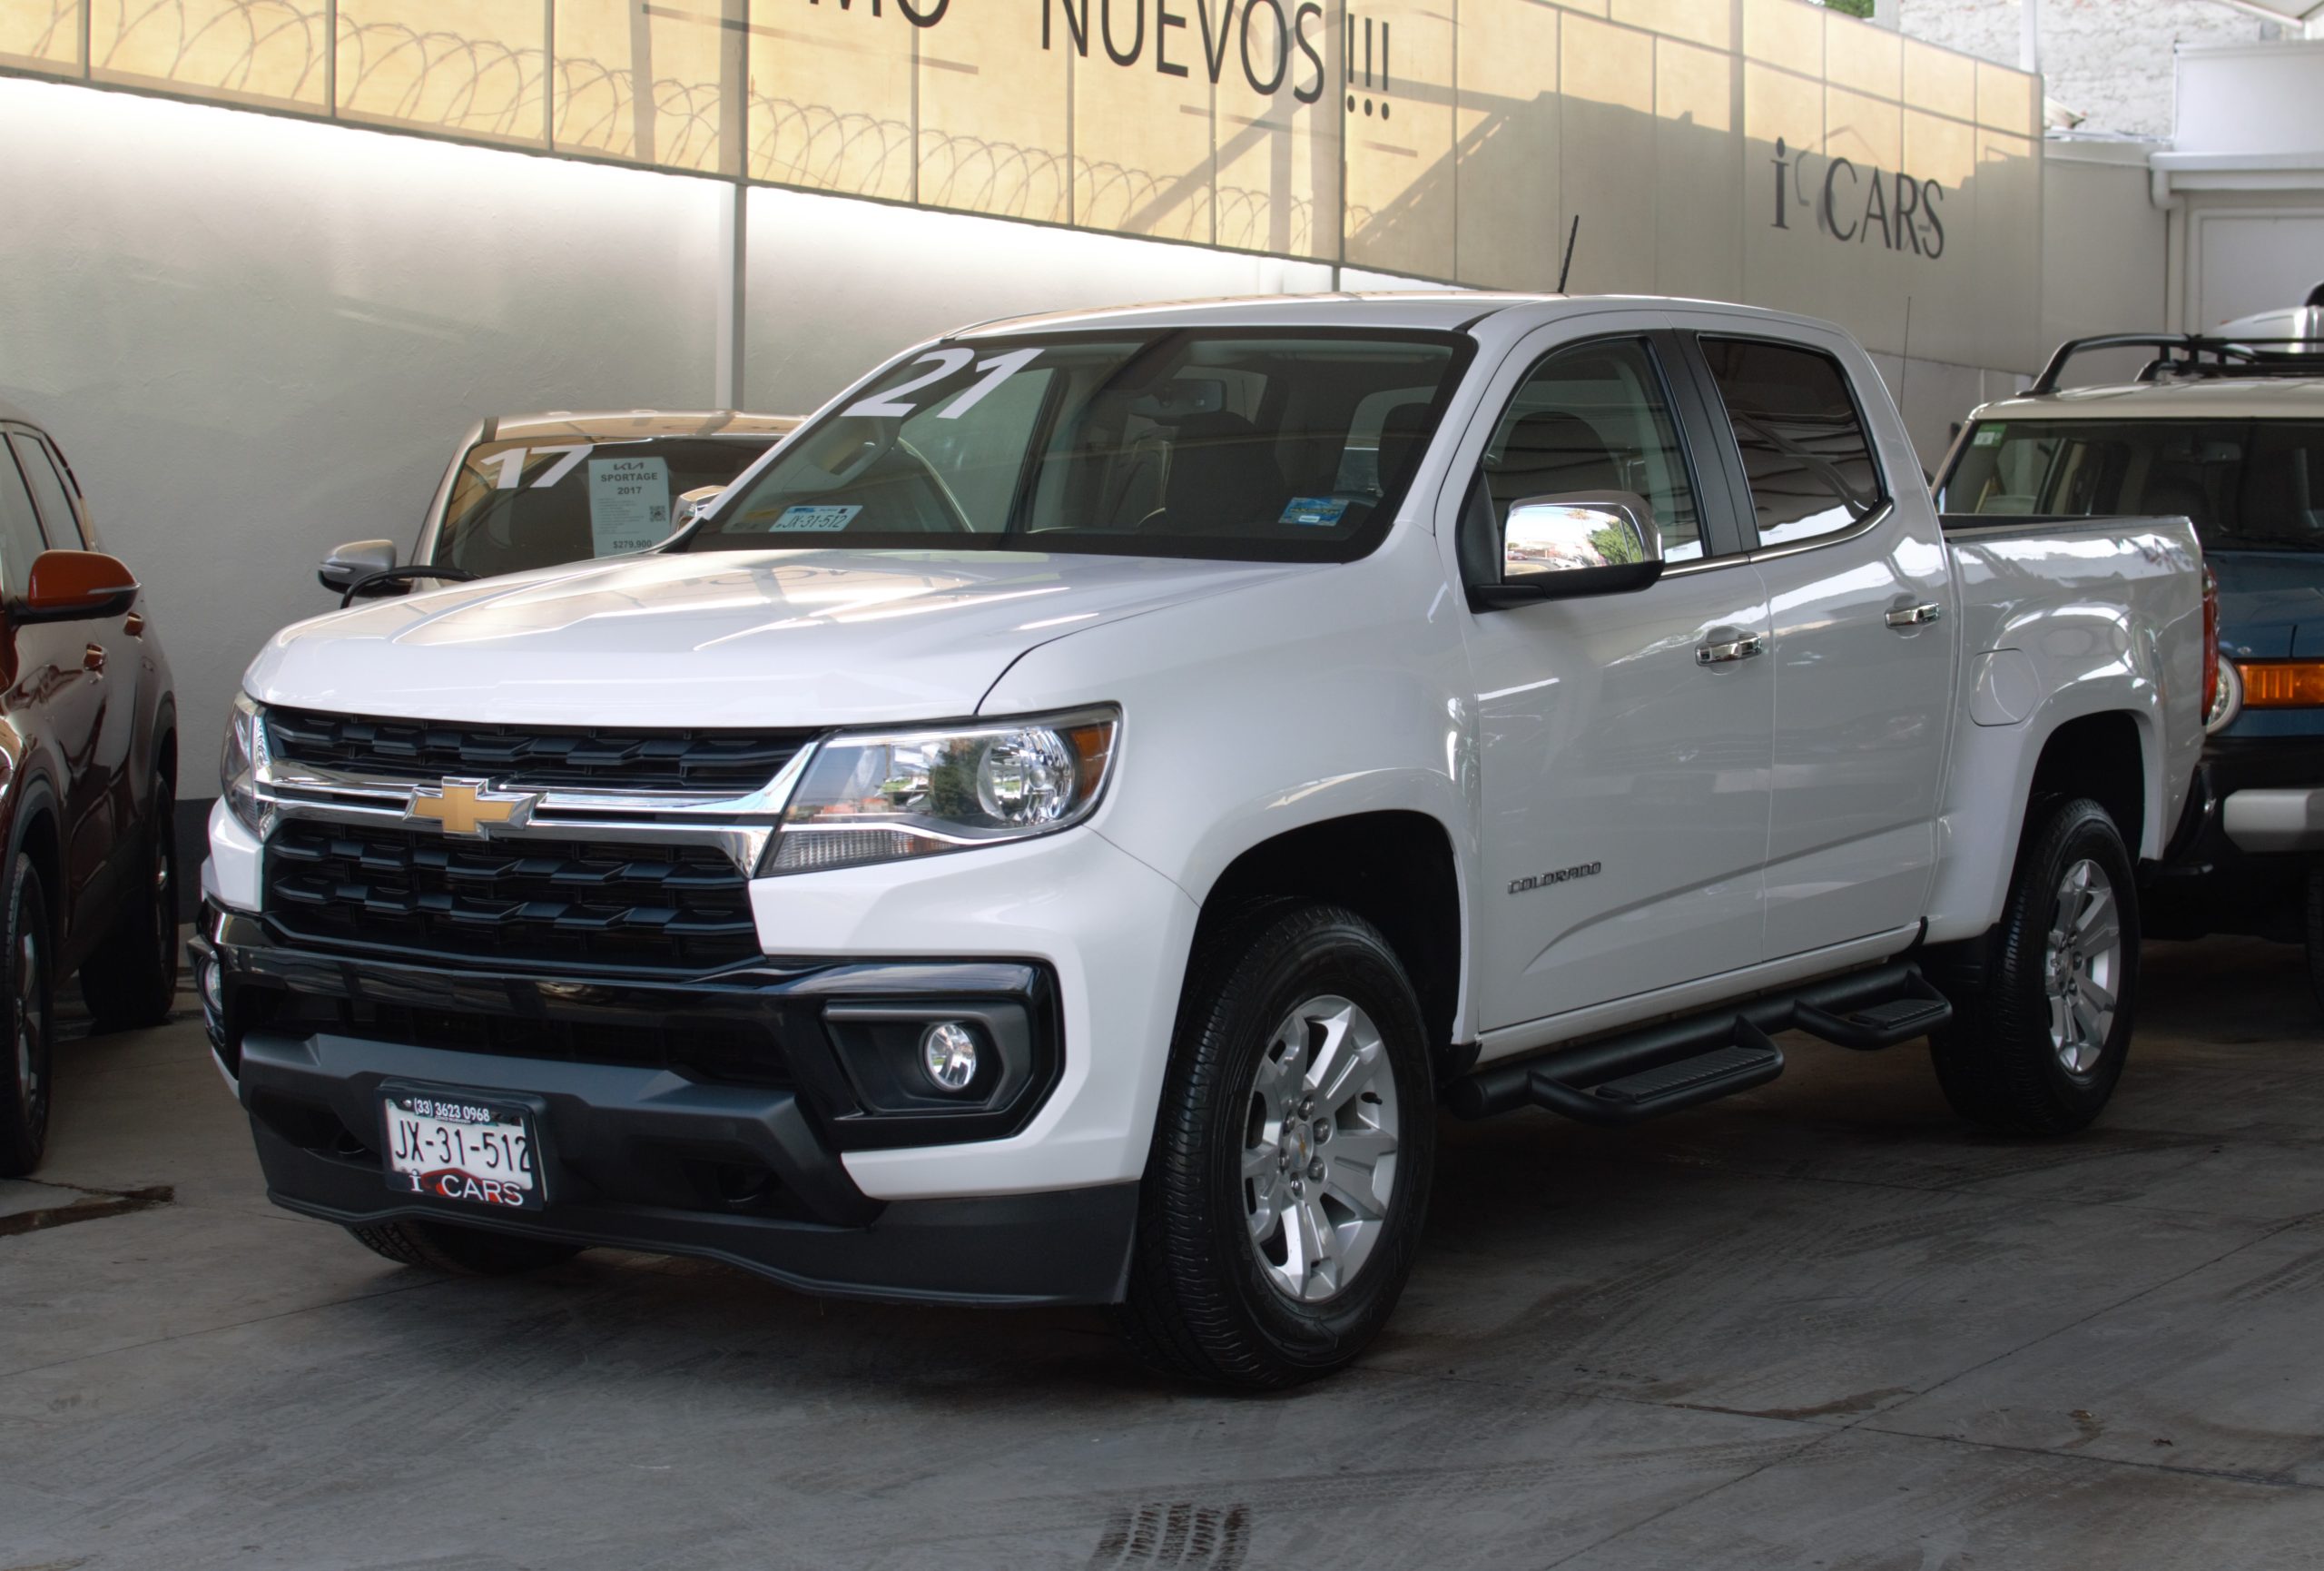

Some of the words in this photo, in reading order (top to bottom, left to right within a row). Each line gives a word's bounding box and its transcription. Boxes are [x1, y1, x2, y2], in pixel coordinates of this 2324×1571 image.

[1824, 156, 1945, 260] CARS
[839, 347, 1046, 420] 21
[480, 443, 595, 489] 17
[601, 473, 658, 482] SPORTAGE
[617, 487, 642, 495] 2017
[1507, 861, 1601, 894] COLORADO
[414, 1097, 433, 1117] (33)
[435, 1102, 461, 1119] 3623
[463, 1106, 490, 1121] 0968
[395, 1119, 532, 1173] JX-31-512
[440, 1173, 524, 1207] CARS
